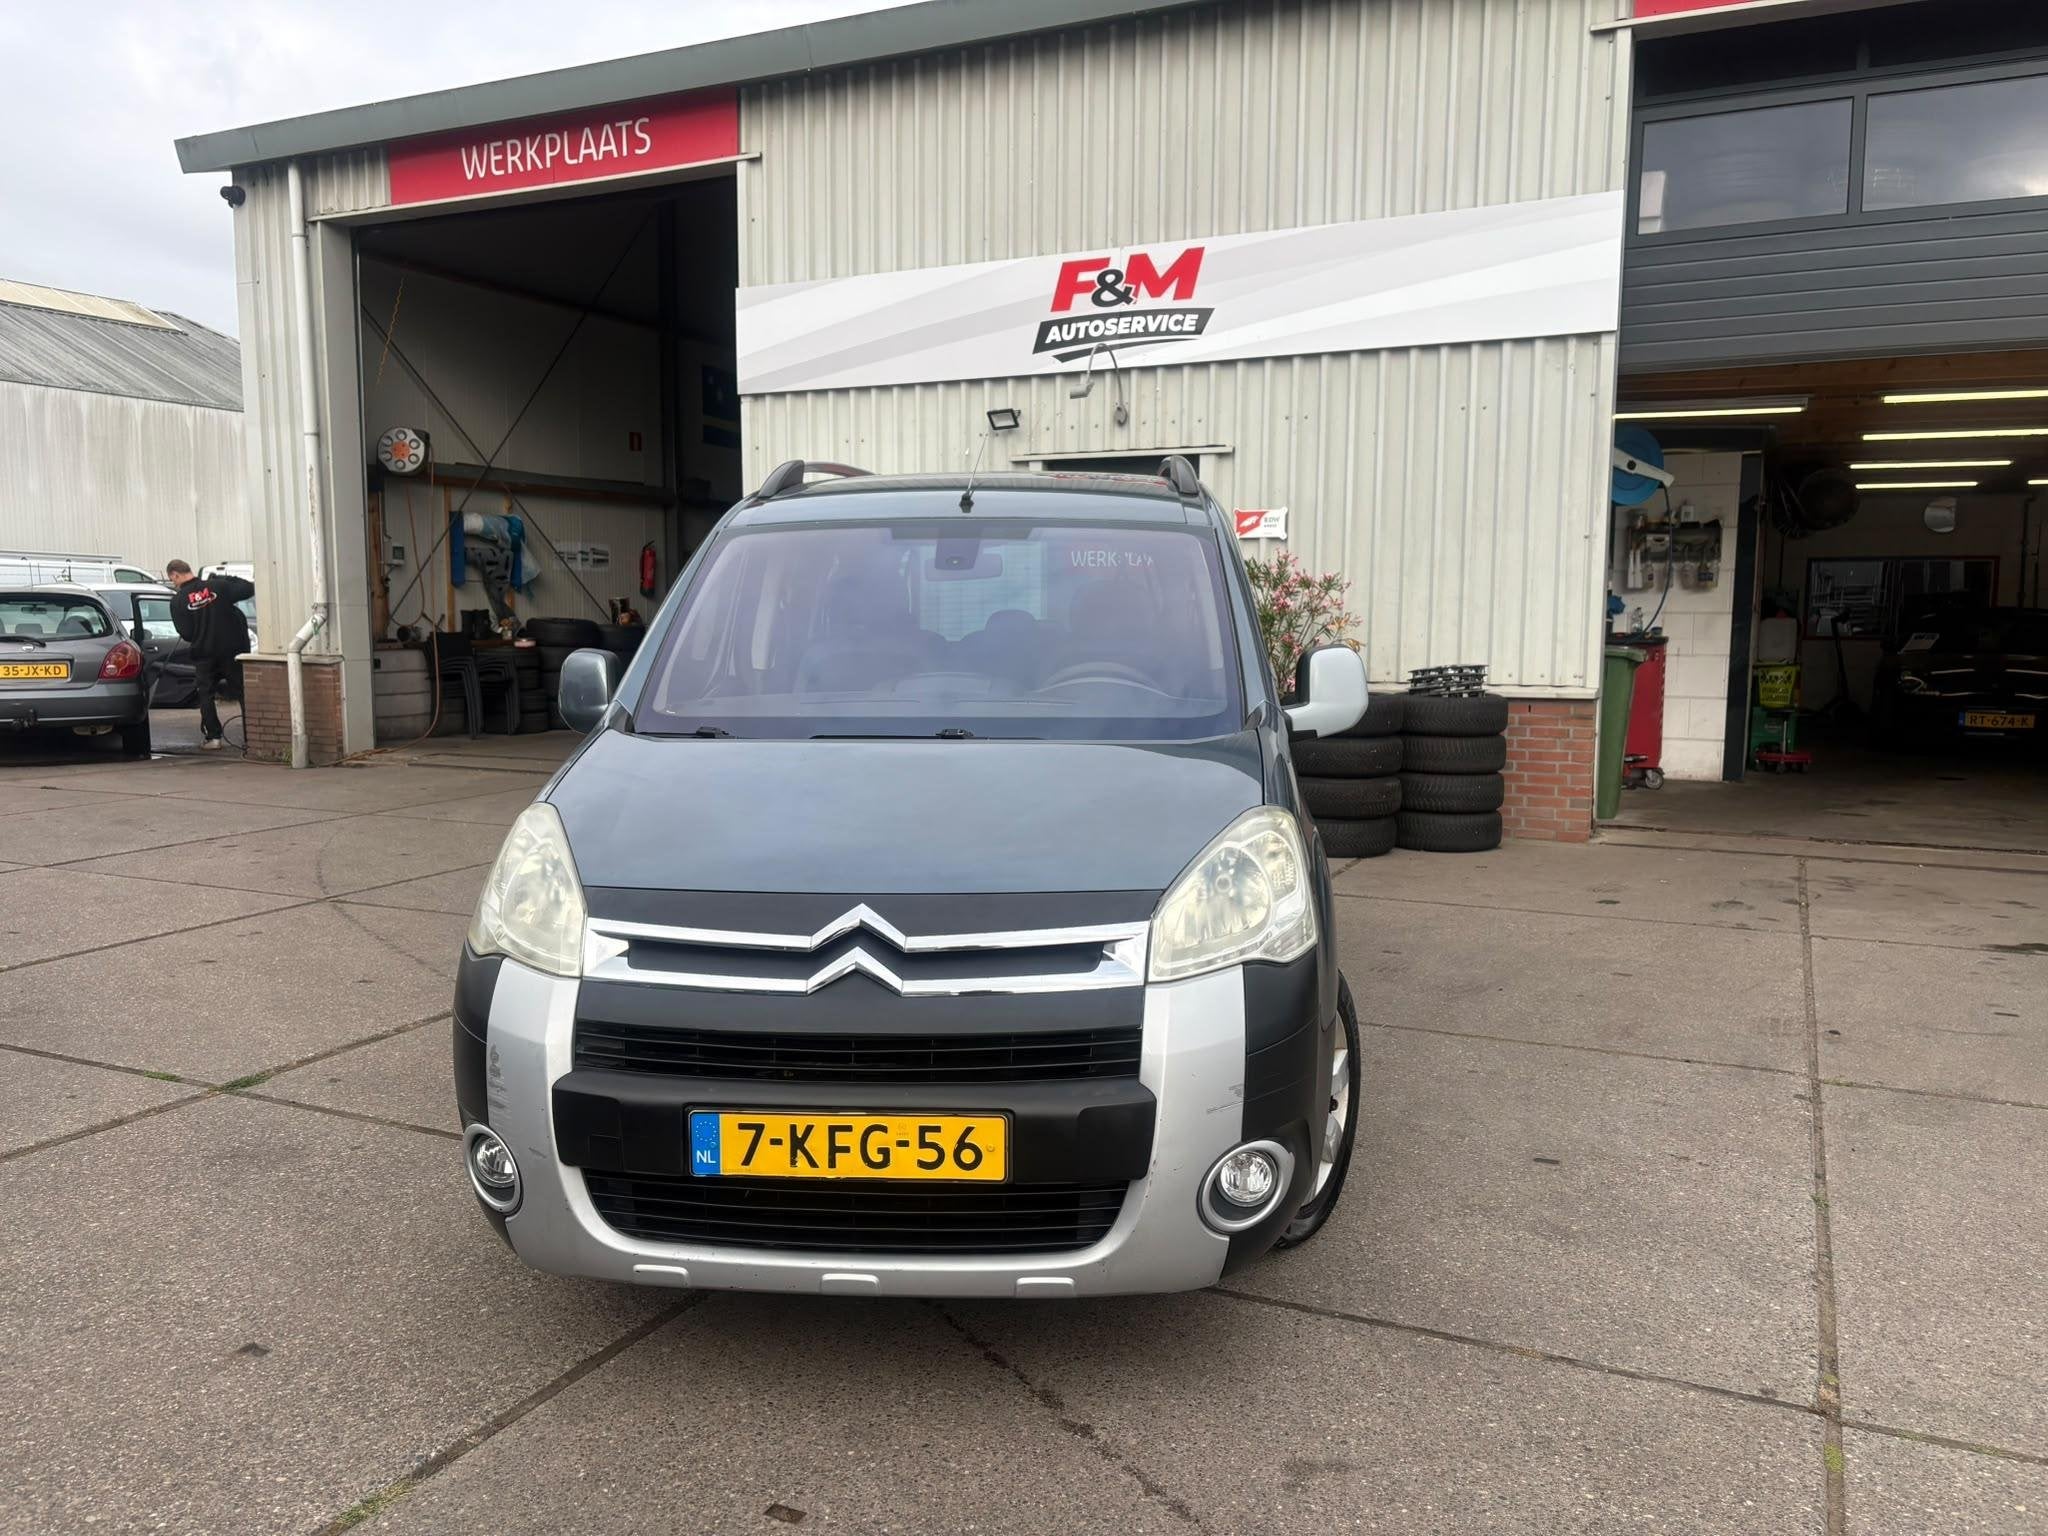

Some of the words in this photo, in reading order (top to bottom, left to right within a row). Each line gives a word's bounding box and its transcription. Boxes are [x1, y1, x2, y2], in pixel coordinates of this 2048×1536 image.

[461, 117, 651, 181] WERKPLAATS
[1051, 246, 1206, 313] F&M
[1044, 313, 1199, 344] AUTOSERVICE
[3, 665, 62, 676] 35-JX-KD
[696, 1149, 716, 1164] NL
[737, 1122, 984, 1171] 7-KFG-56
